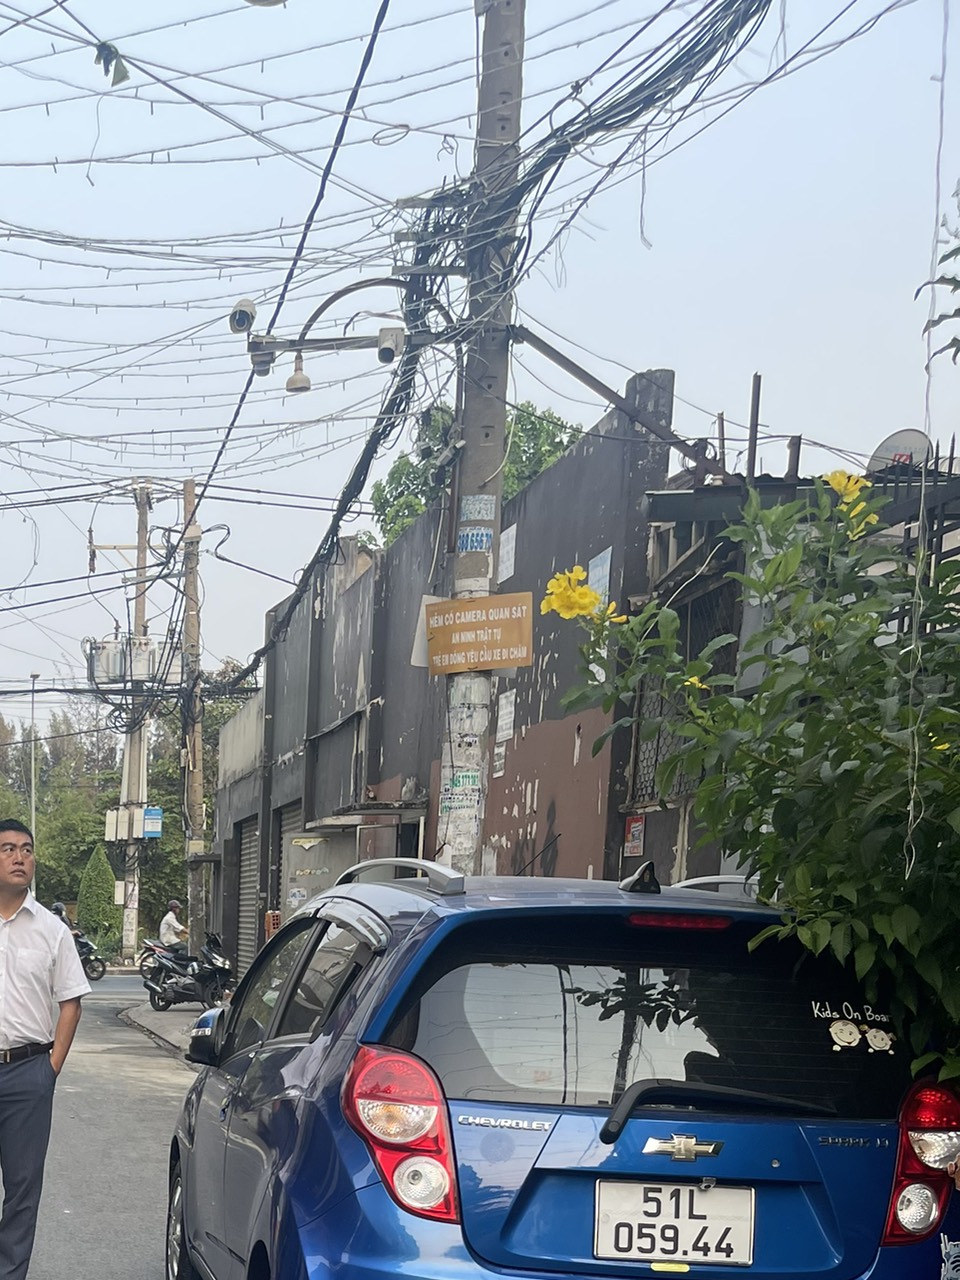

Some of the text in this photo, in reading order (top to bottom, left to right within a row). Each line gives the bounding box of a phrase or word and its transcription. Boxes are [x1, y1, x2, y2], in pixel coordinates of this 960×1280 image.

[444, 610, 454, 625] CÓ
[455, 608, 487, 624] CAMERA
[488, 606, 511, 621] QUAN
[511, 603, 527, 619] SÁT
[451, 631, 459, 644] AN
[460, 629, 476, 643] NINH
[476, 627, 492, 644] TRẬT
[466, 648, 478, 663] YÊU
[492, 648, 501, 660] XE
[811, 1000, 840, 1019] Kids
[842, 1001, 862, 1020] On
[458, 1115, 552, 1132] CHEVROLET
[643, 1186, 707, 1220] 51L
[614, 1222, 734, 1258] 059.44
